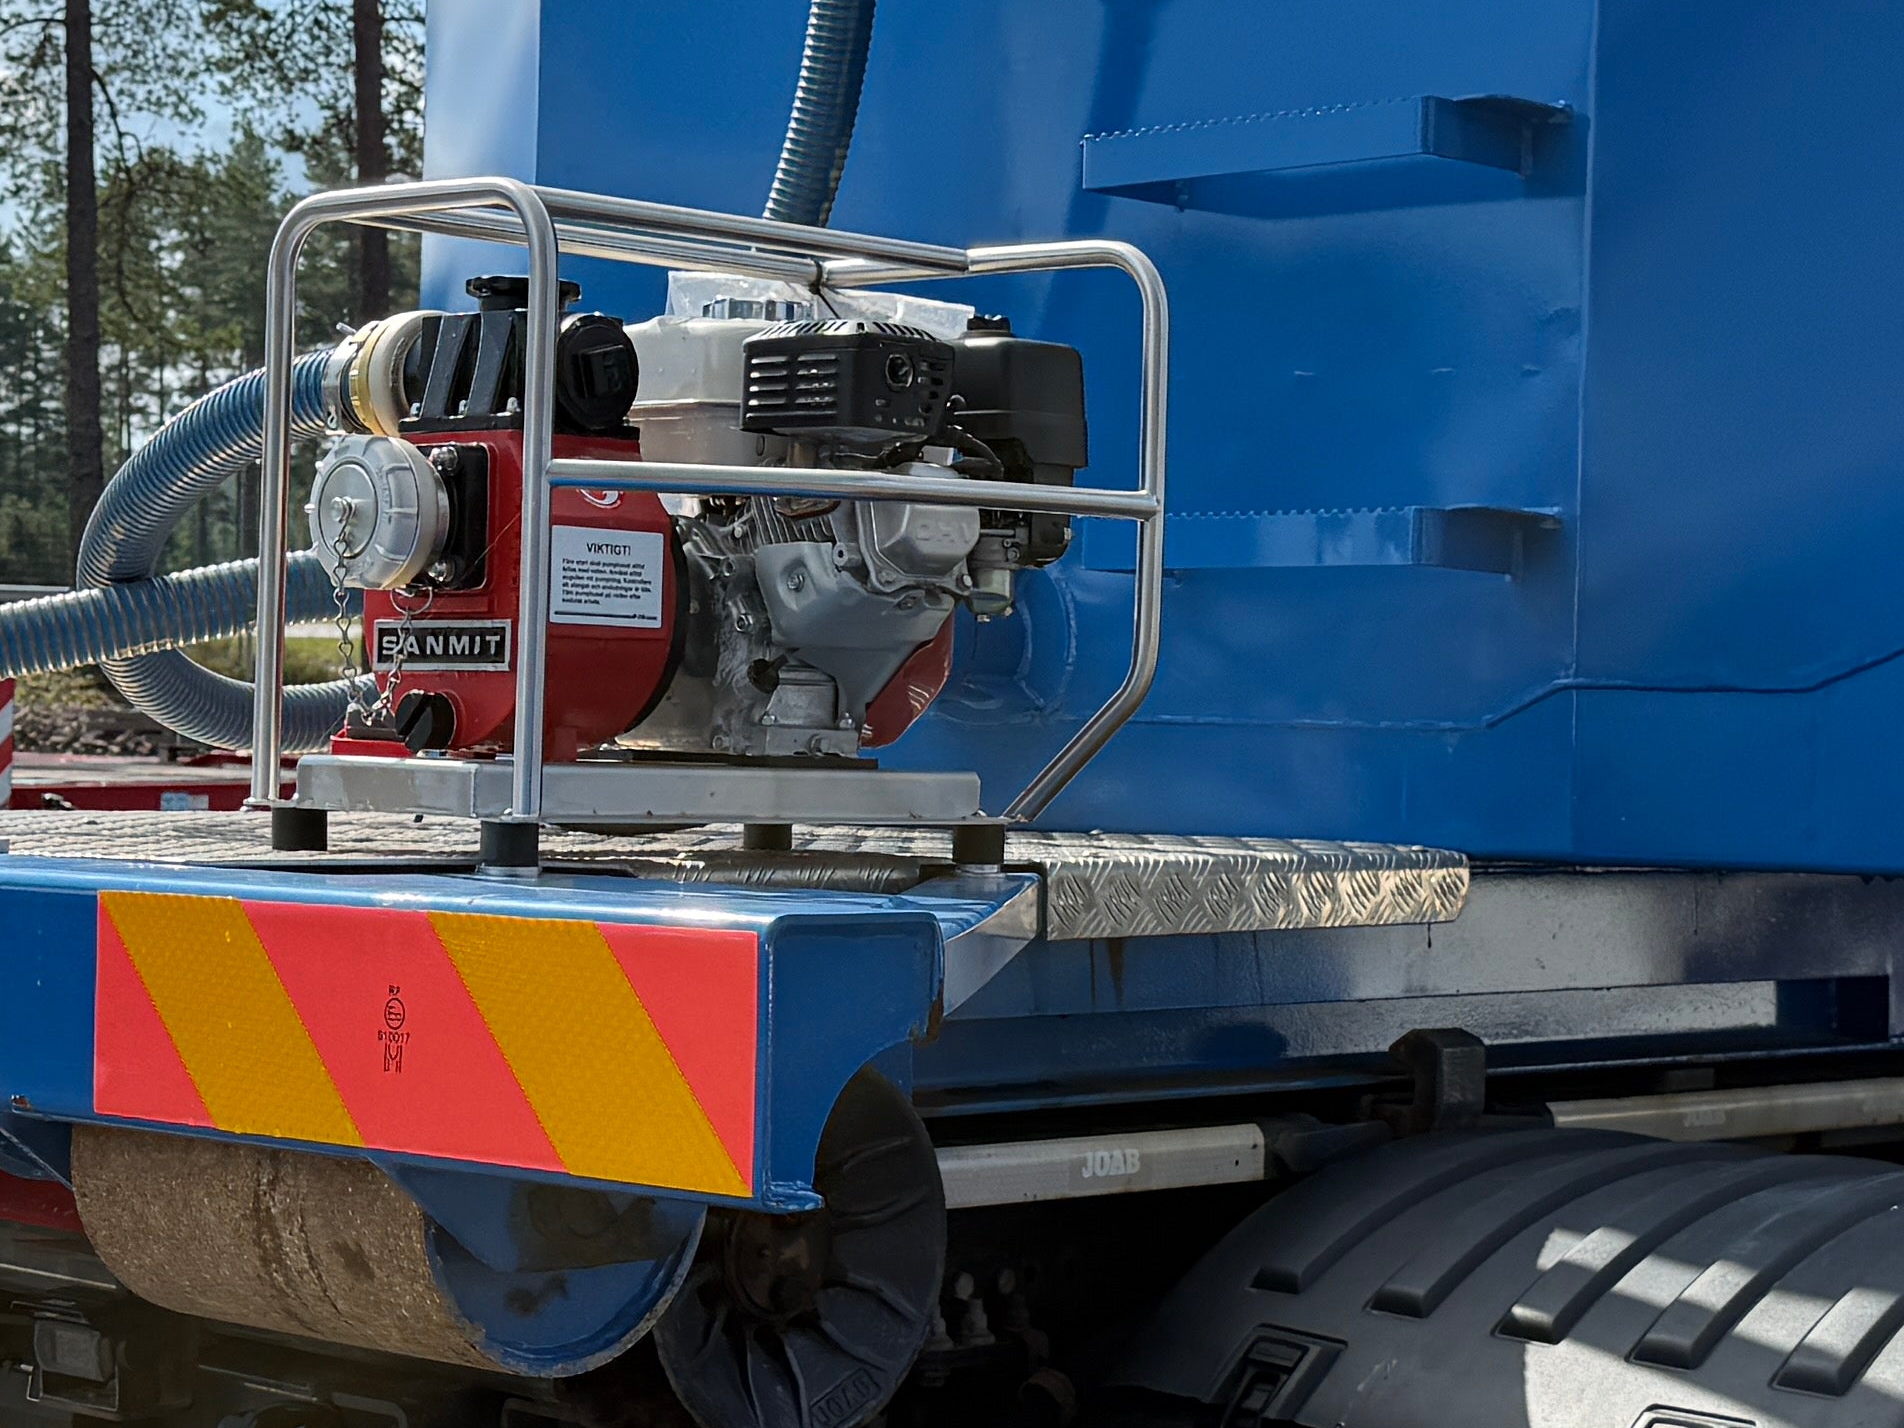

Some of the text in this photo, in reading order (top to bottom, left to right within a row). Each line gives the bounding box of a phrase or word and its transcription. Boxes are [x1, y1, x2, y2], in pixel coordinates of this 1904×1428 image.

[586, 542, 631, 557] VIKTIGT!
[382, 635, 501, 655] SANMIT
[1081, 1148, 1141, 1179] JOAB
